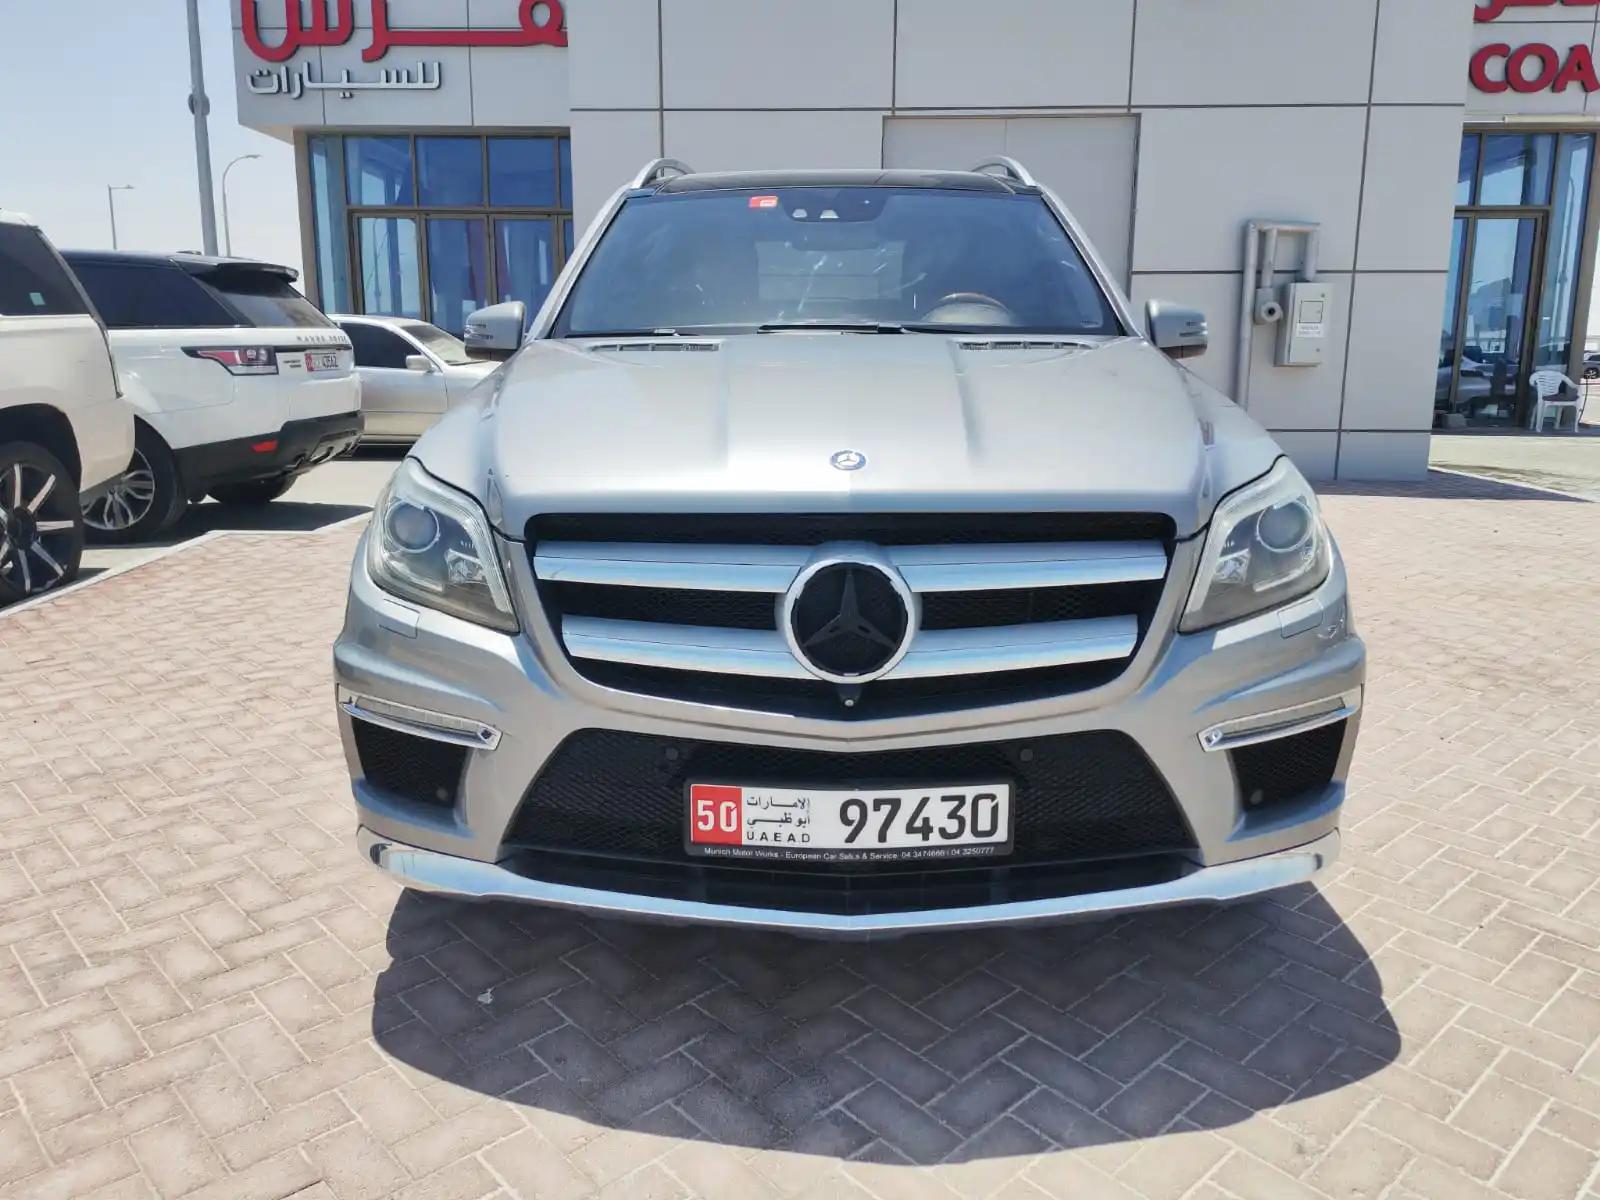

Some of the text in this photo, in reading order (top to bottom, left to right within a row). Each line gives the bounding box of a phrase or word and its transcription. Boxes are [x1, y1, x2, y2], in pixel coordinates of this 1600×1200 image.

[246, 60, 441, 99] للسيارات
[697, 799, 738, 832] 50
[839, 793, 999, 843] 97430
[785, 851, 821, 860] European
[869, 852, 898, 860] Service
